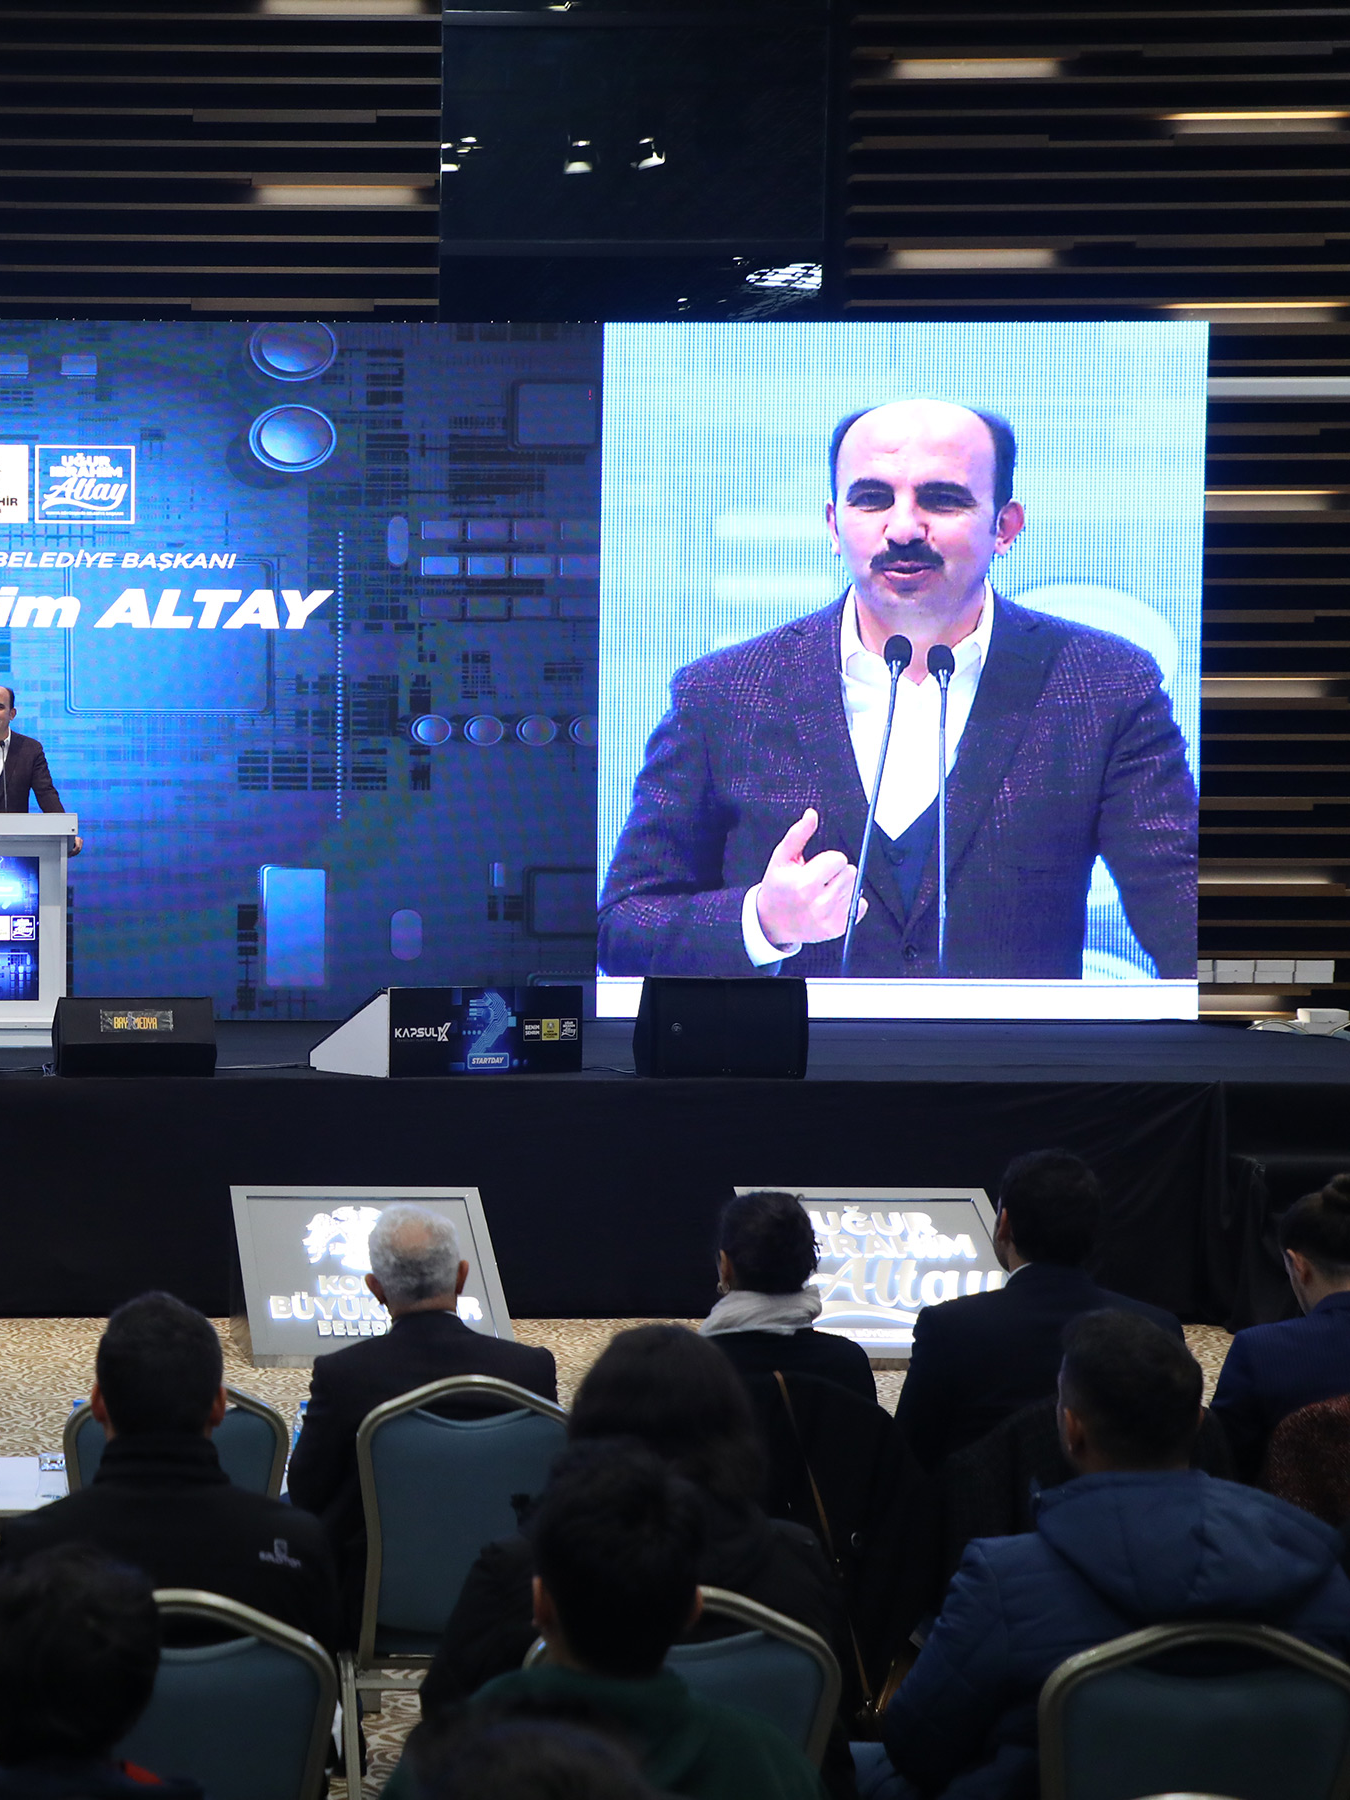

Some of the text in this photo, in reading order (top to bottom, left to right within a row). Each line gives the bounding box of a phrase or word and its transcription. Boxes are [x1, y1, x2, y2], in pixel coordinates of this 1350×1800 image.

[121, 552, 237, 571] BAŞKANI
[93, 588, 335, 629] ALTAY
[471, 1057, 504, 1065] STARTDAY
[808, 1206, 938, 1236] UĞUR
